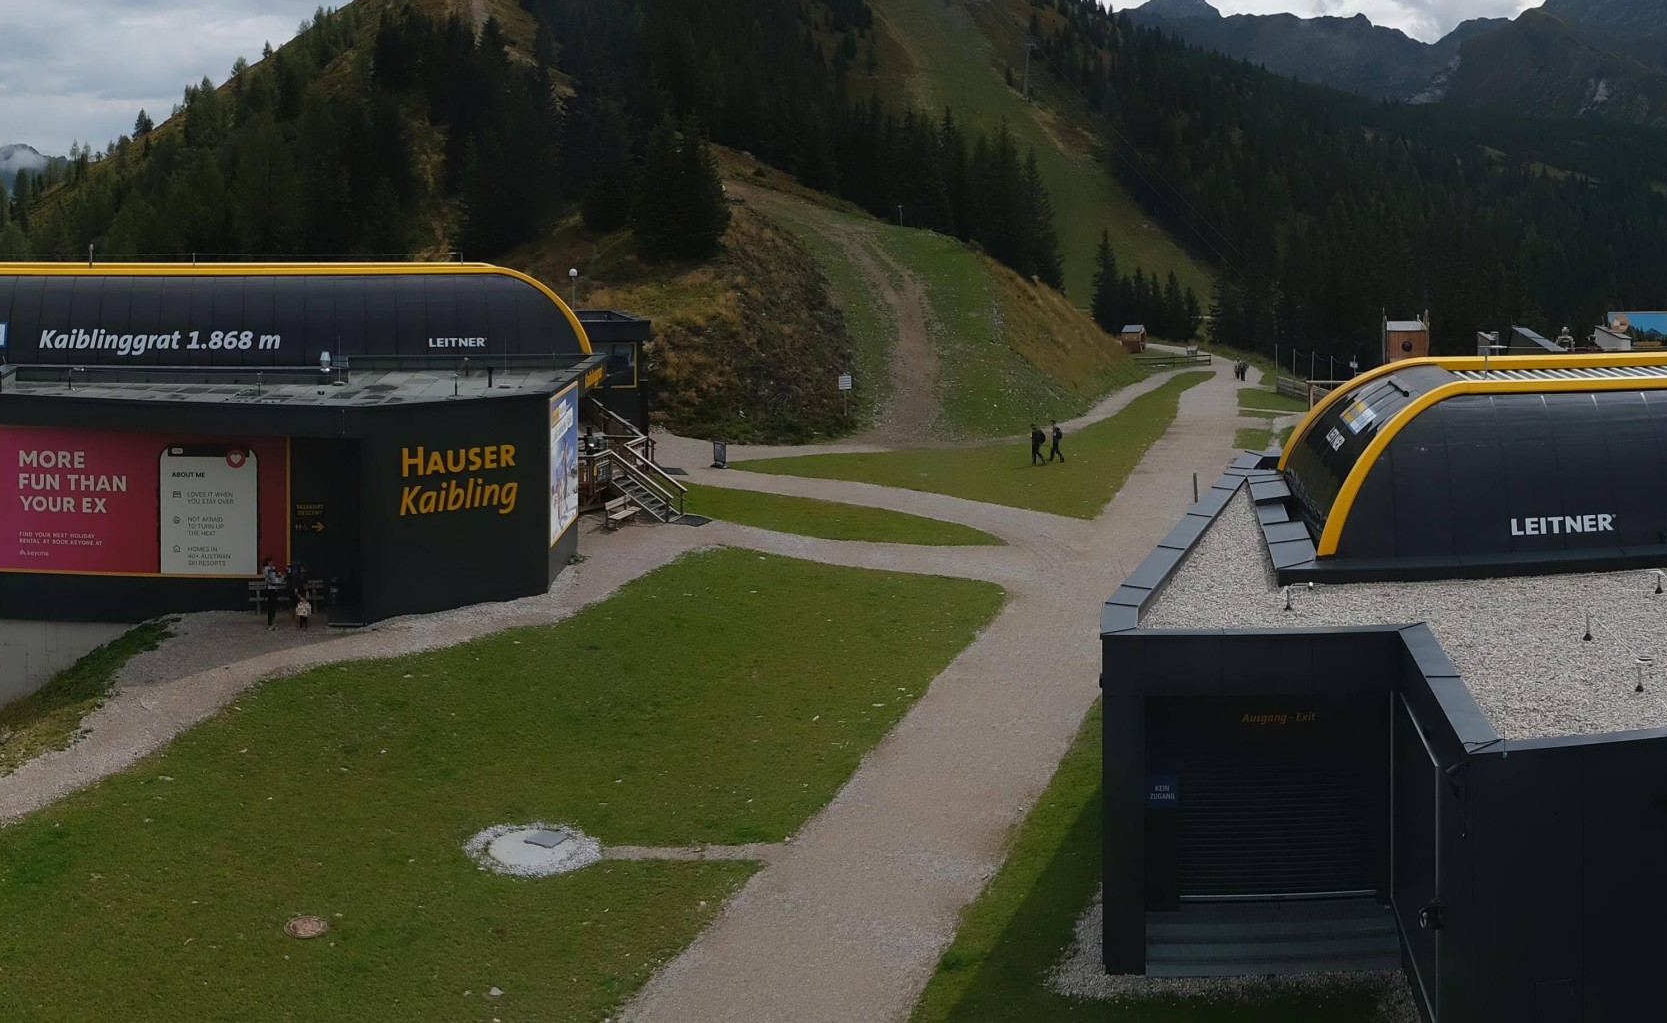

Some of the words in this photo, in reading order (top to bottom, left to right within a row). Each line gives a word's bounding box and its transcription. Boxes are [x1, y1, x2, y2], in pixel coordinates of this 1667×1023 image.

[39, 329, 180, 356] Kaiblinggrat
[186, 331, 253, 350] 1.868
[258, 333, 281, 349] m
[428, 337, 485, 348] LEITNER
[18, 450, 85, 469] MORE
[401, 444, 516, 478] HAUSER
[18, 473, 60, 492] FUN
[66, 474, 127, 492] THAN
[19, 496, 76, 513] YOUR
[82, 497, 107, 514] EX
[399, 478, 518, 516] Kaibling
[1510, 513, 1614, 536] LEITNER
[1242, 713, 1288, 725] Ausgang
[1296, 711, 1317, 722] Exit
[1149, 792, 1175, 801] ZUGANG
[1155, 784, 1170, 792] KEIN
